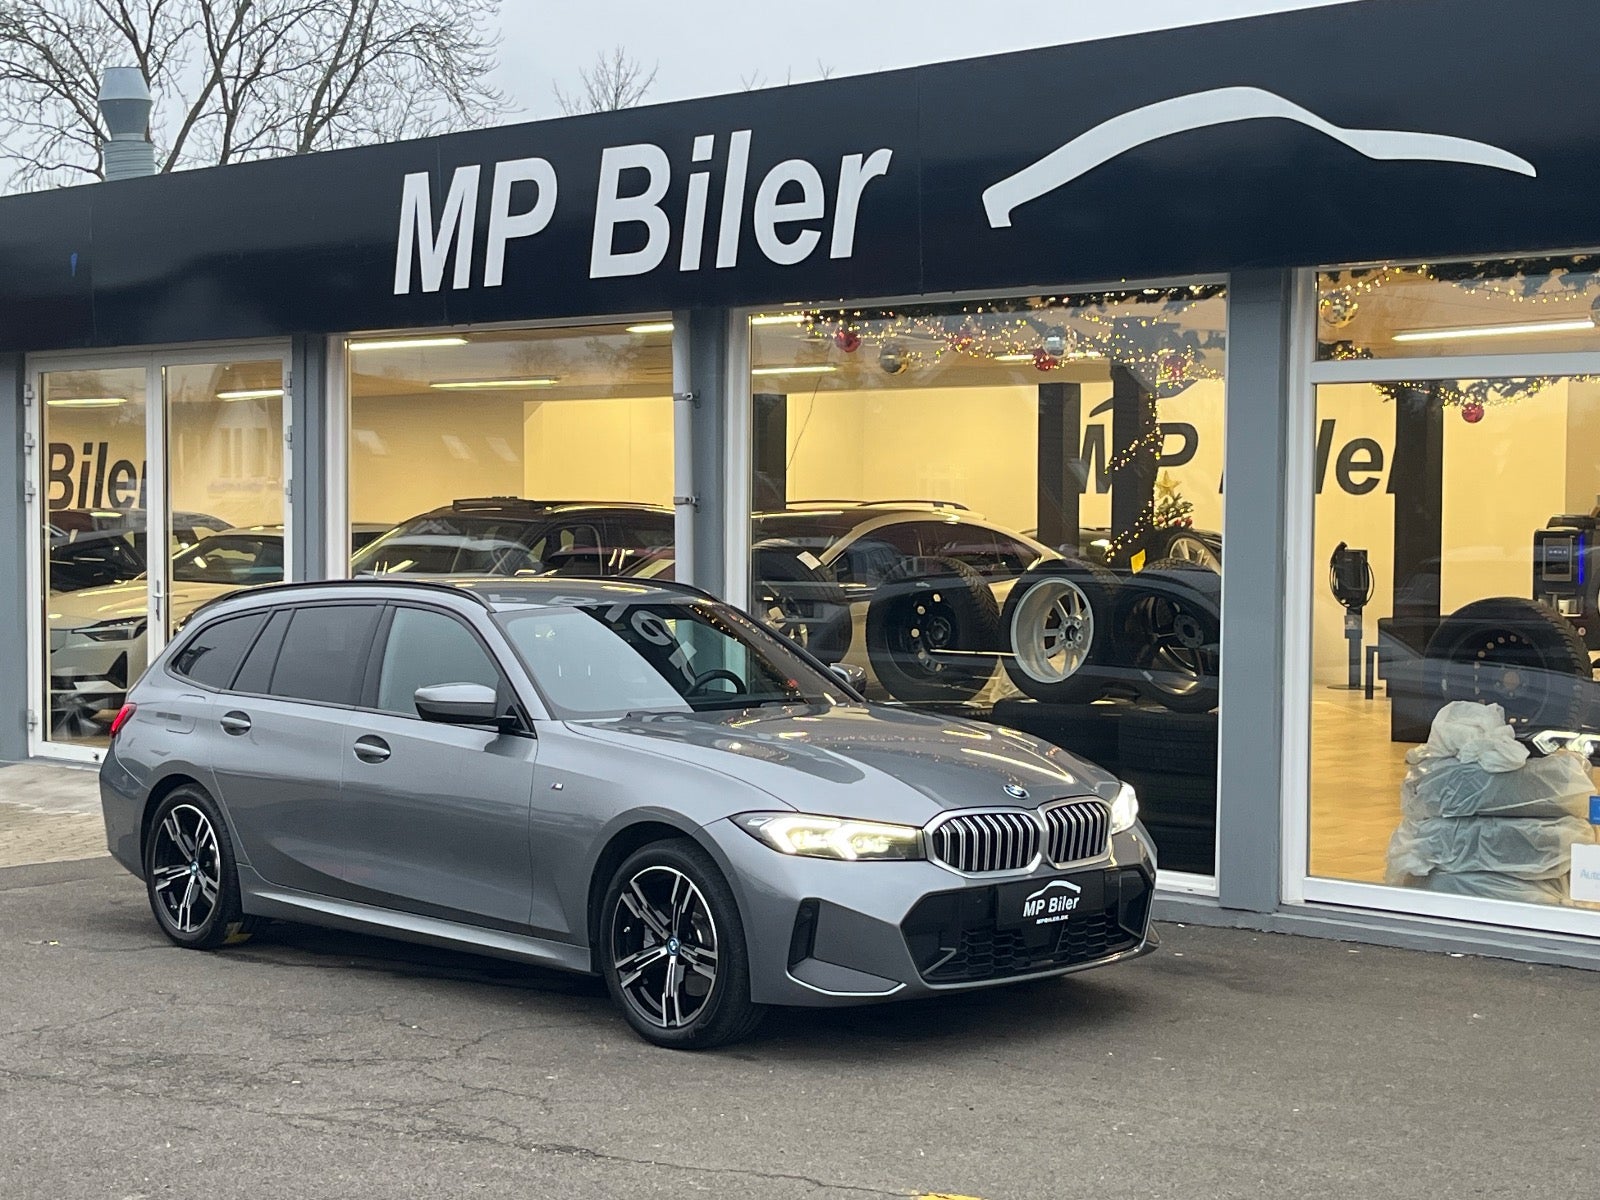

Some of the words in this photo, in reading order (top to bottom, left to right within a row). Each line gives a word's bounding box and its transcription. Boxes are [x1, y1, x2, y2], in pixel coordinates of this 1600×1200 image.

[393, 157, 558, 295] MP
[589, 129, 893, 279] Biler
[1023, 899, 1046, 917] MP
[1048, 895, 1080, 913] Biler
